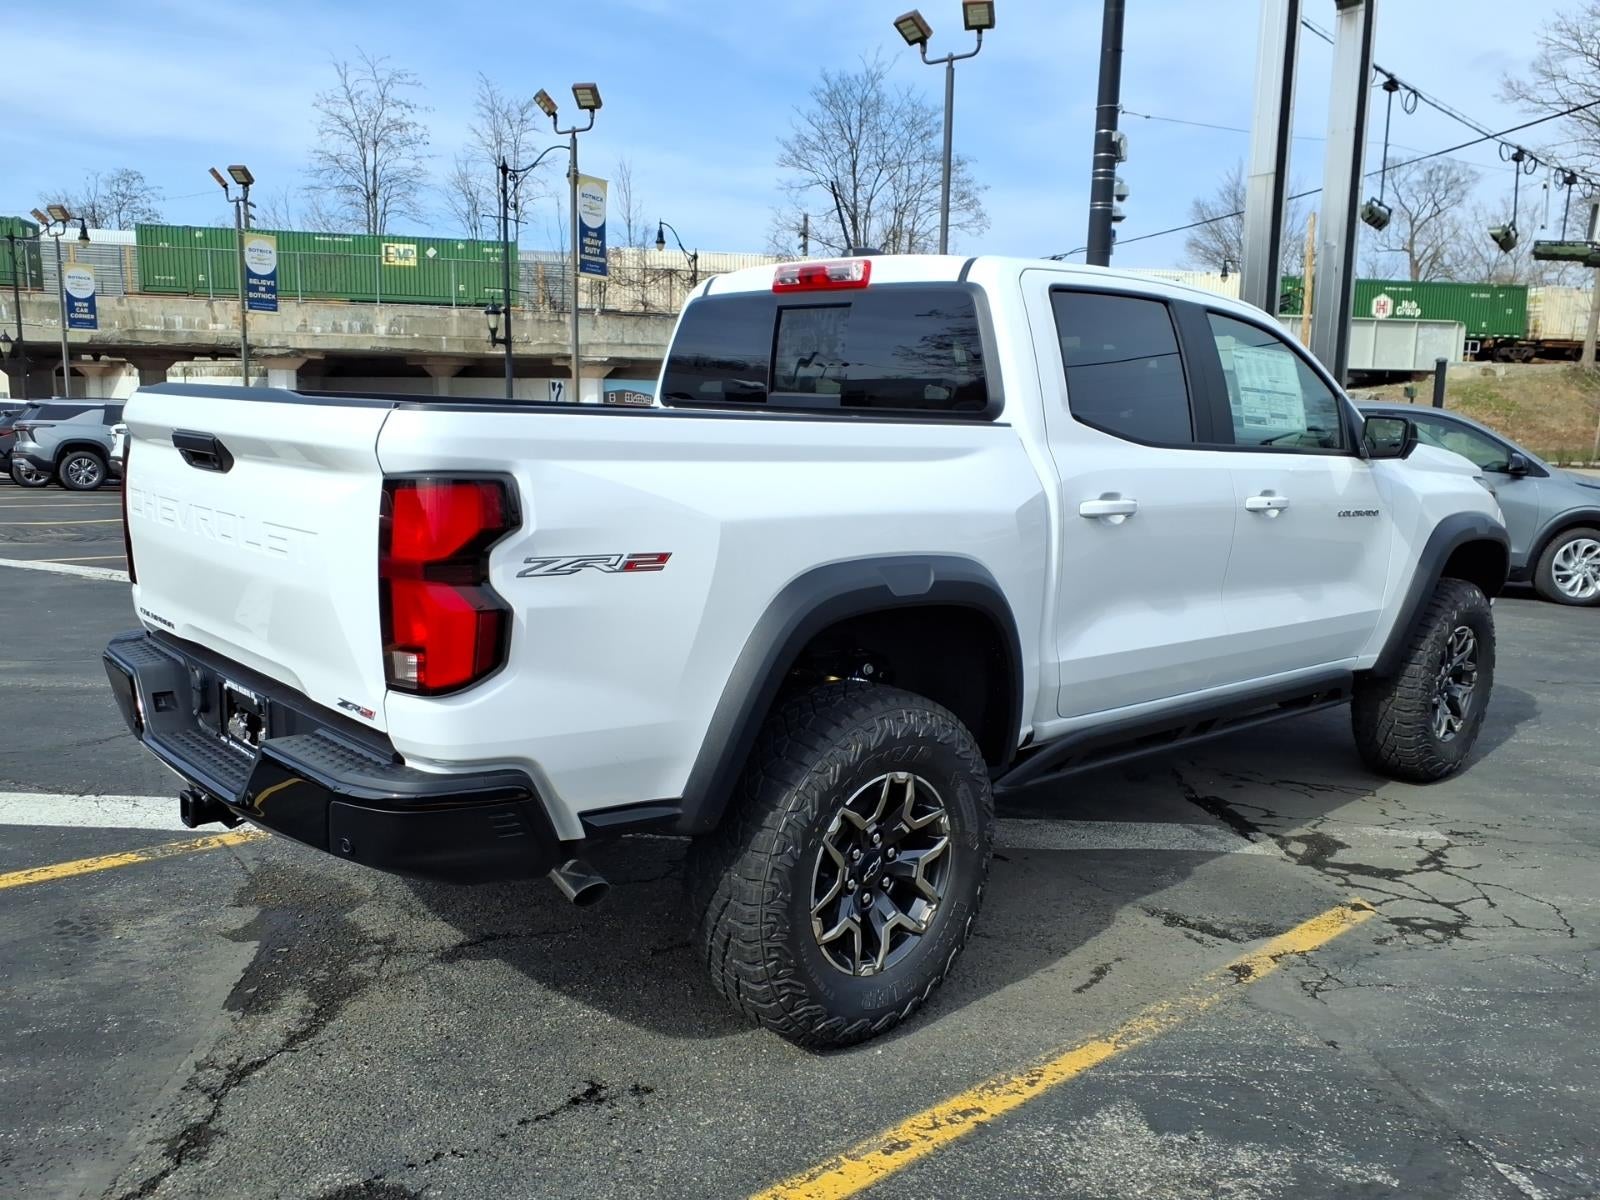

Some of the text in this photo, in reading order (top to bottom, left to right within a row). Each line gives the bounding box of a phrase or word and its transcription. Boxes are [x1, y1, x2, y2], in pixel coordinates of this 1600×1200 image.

[582, 237, 602, 247] HEAVY
[585, 246, 601, 255] DUTY
[248, 278, 275, 286] BELIEVE
[248, 291, 277, 300] BOTNICK
[1401, 300, 1418, 308] Hub
[1396, 306, 1421, 318] Group
[516, 552, 673, 578] ZR2
